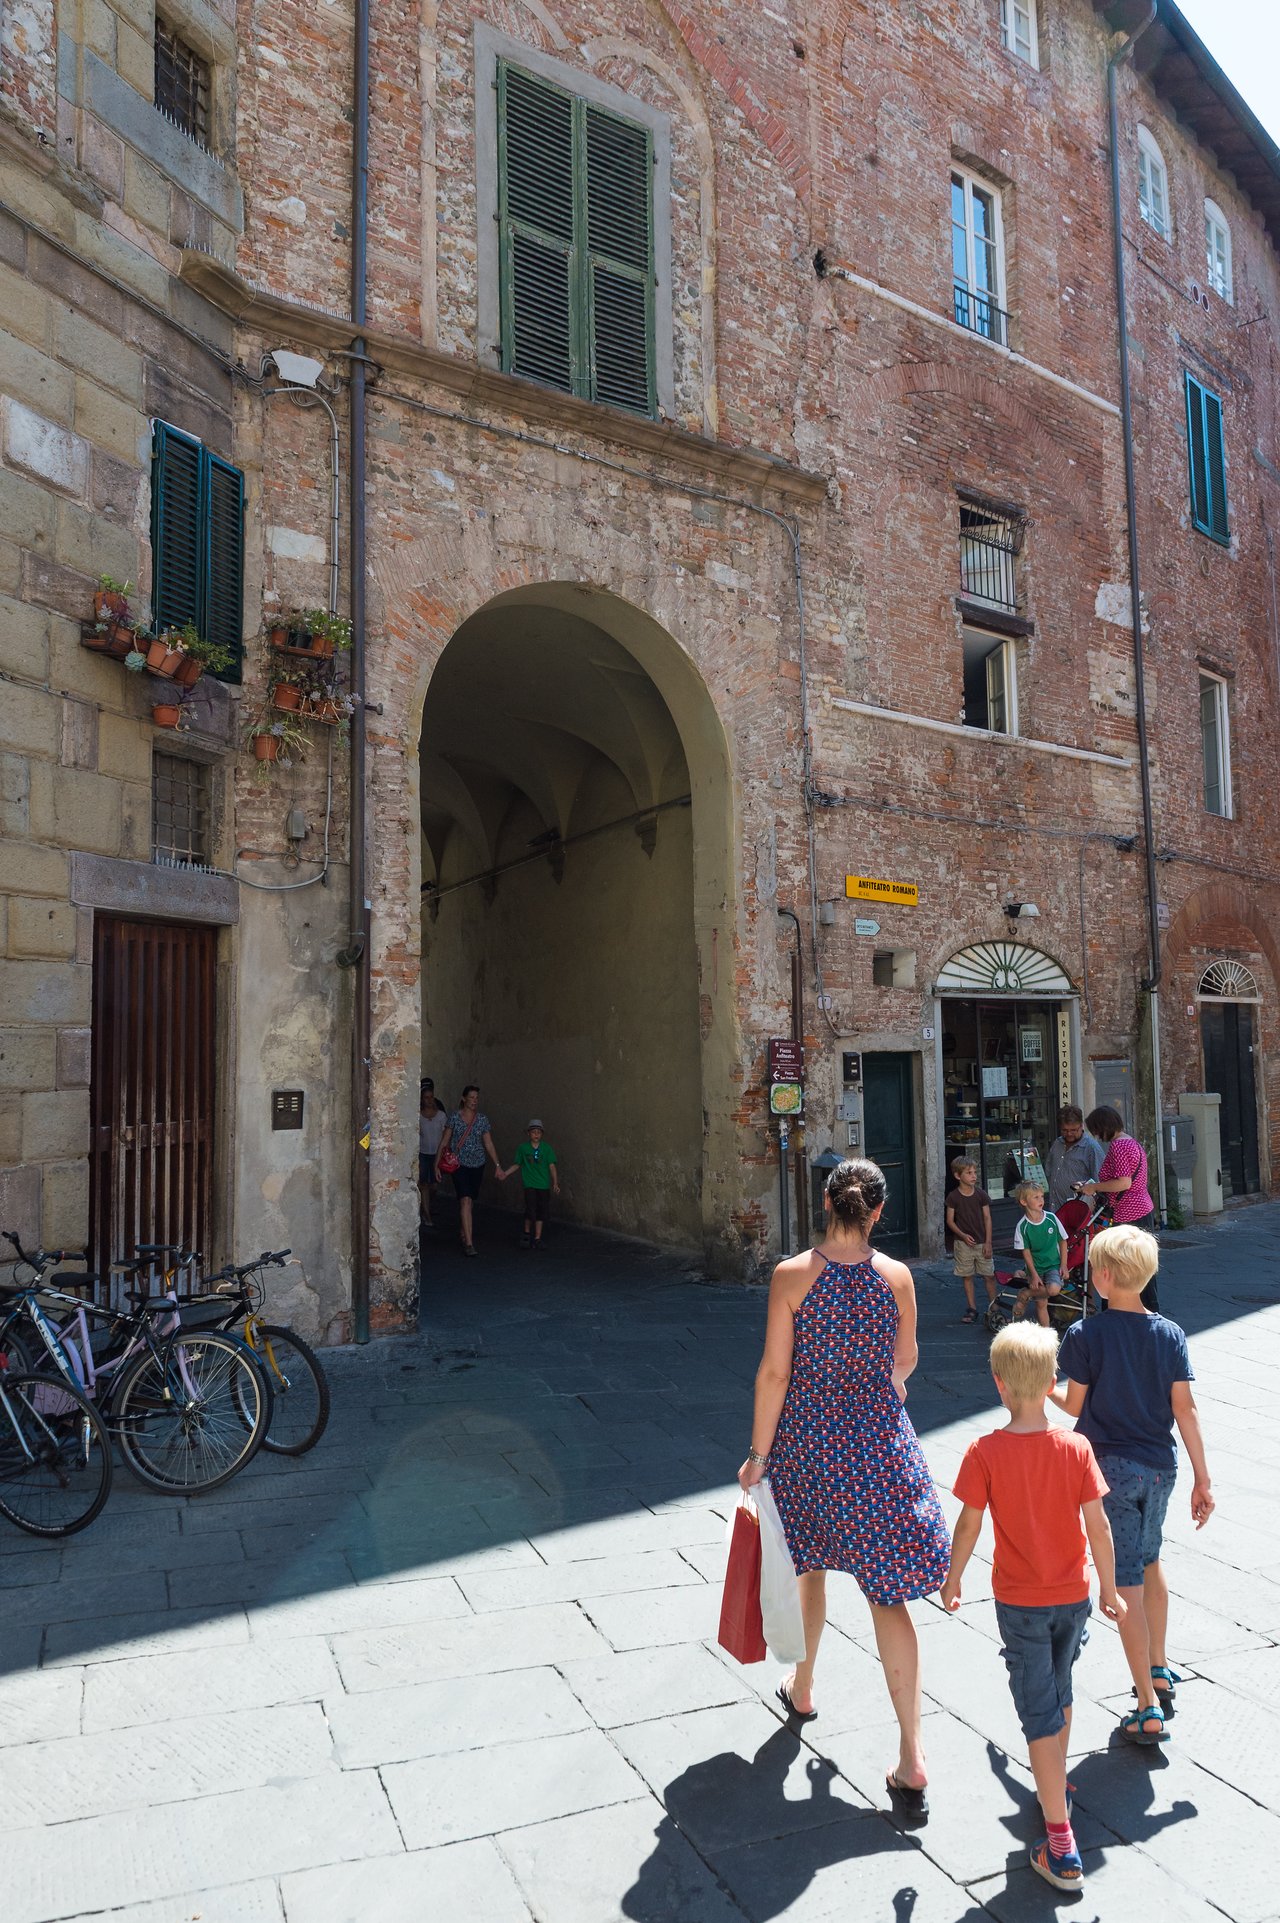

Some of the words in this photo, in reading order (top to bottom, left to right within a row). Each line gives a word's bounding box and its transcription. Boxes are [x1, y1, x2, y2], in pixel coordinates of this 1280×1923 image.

[859, 880, 890, 892] ANFITEATRO
[893, 885, 915, 896] ROMANO
[926, 1028, 931, 1038] 5
